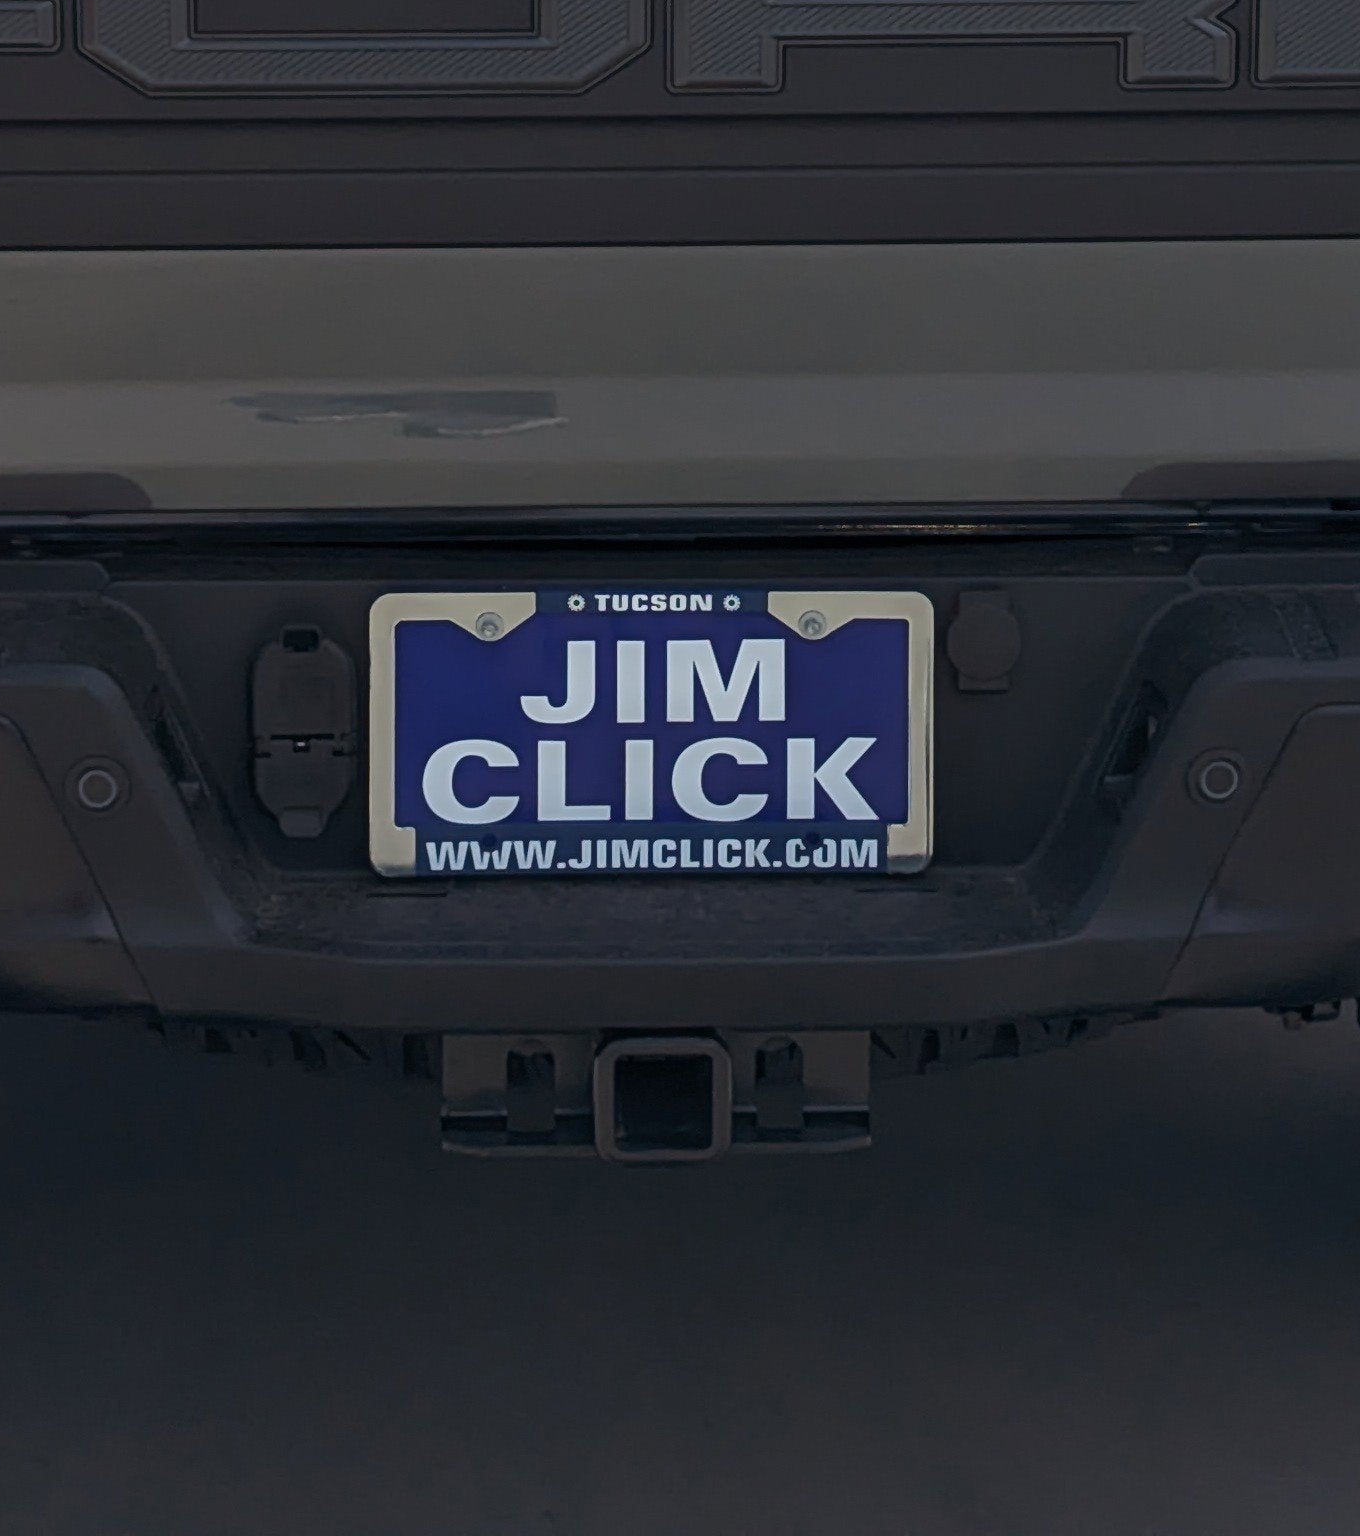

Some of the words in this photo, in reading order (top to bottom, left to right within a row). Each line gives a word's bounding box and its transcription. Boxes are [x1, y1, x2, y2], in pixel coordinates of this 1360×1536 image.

[594, 594, 714, 612] TUCSON
[520, 638, 786, 724] JIM
[422, 736, 879, 824] CLICK
[426, 838, 879, 870] WWW.JIMCLICK.COM
